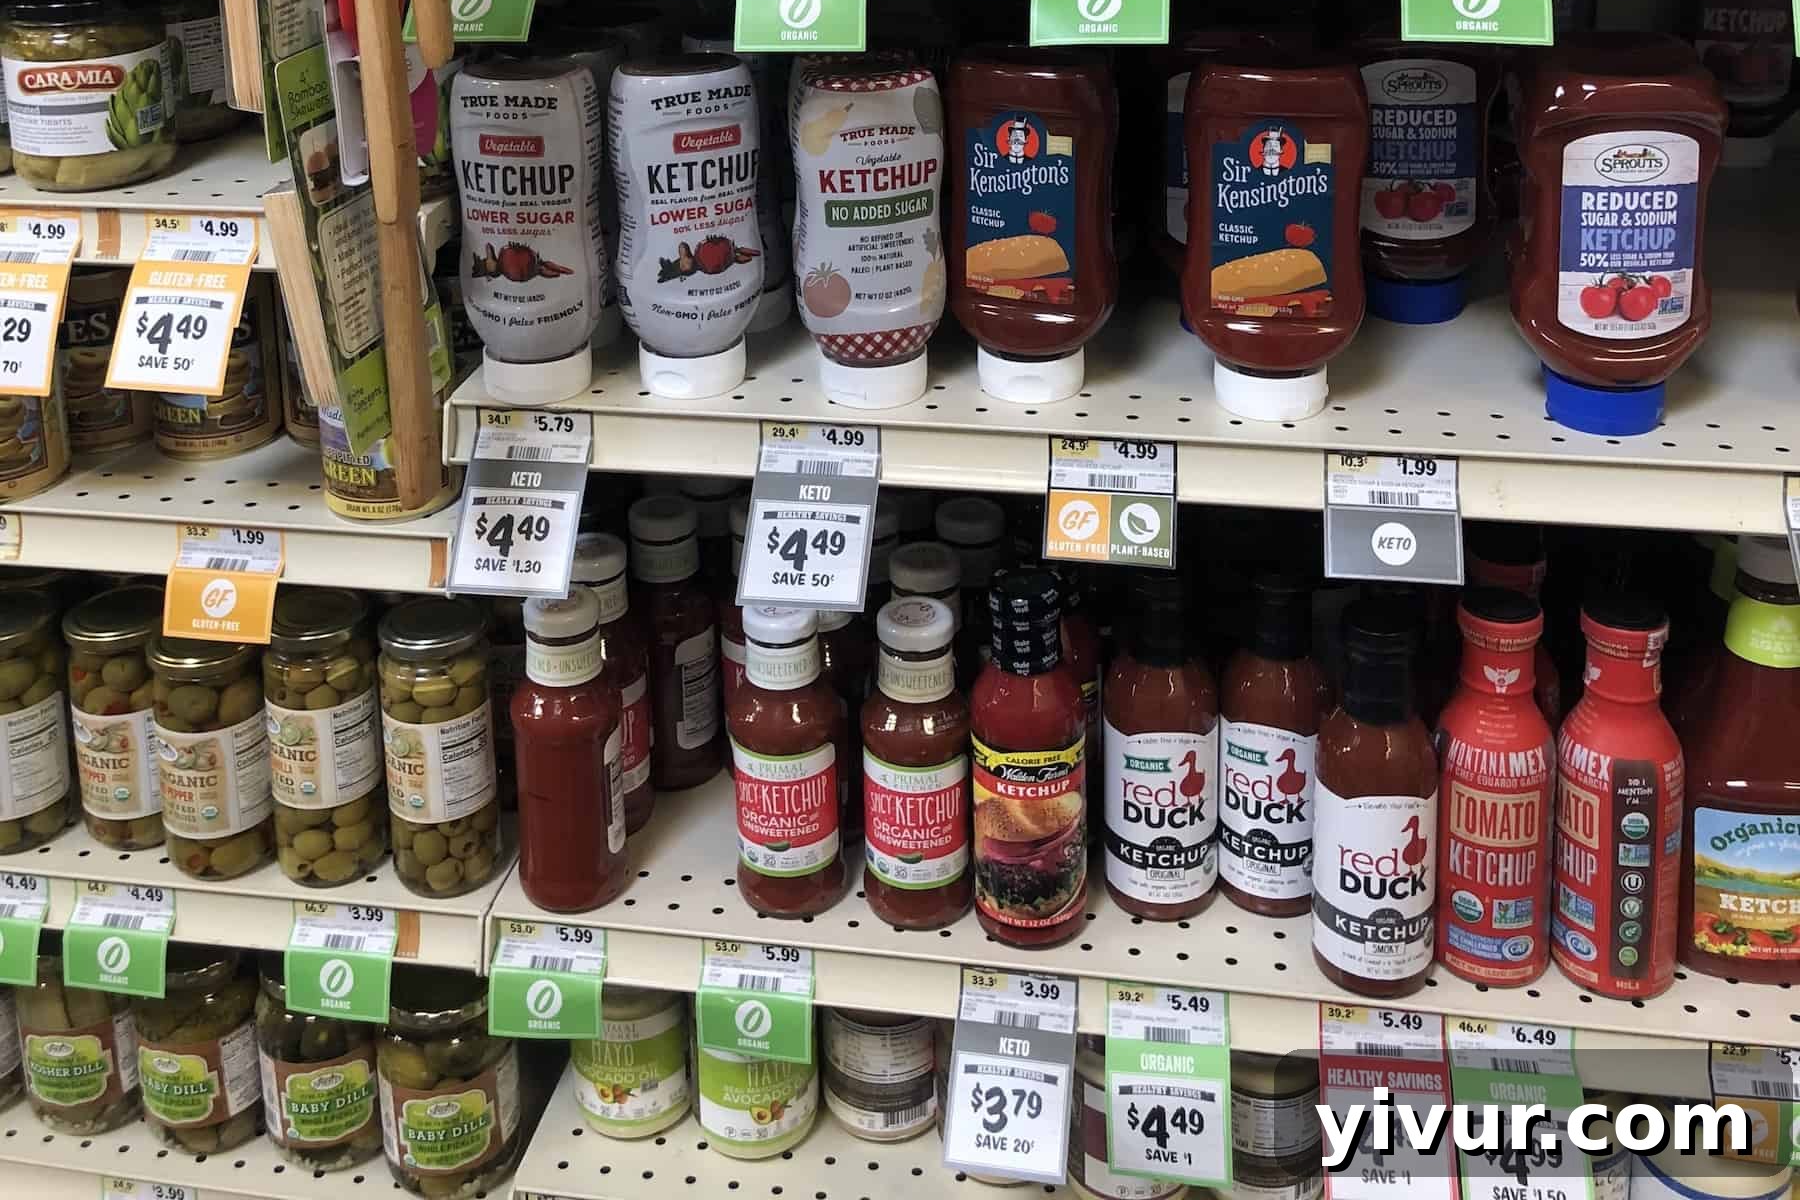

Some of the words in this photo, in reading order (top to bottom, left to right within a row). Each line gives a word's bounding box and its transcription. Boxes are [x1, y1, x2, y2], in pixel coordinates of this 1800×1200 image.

[781, 31, 818, 41] ORGANIC
[23, 73, 74, 90] CARA
[77, 70, 114, 87] MIA
[461, 95, 500, 109] TRUE
[504, 95, 558, 110] MADE
[651, 94, 702, 110] TRUE
[706, 85, 752, 100] MADE
[485, 111, 528, 120] FOODS
[1372, 109, 1457, 126] REDUCED
[974, 143, 999, 170] Sir
[462, 162, 575, 195] KETCHUP
[818, 159, 938, 193] KETCHUP
[1223, 157, 1251, 183] Sir
[831, 208, 849, 221] NO
[852, 202, 892, 220] ADDED
[894, 197, 927, 215] SUGAR
[1581, 191, 1678, 211] REDUCED
[466, 208, 511, 223] LOWER
[516, 210, 574, 225] SUGAR
[971, 206, 1001, 218] CLASSIC
[1581, 212, 1618, 226] SUGAR
[1621, 213, 1633, 225] &
[1635, 212, 1677, 225] SODIUM
[199, 219, 239, 238] $4.99
[971, 215, 1005, 228] KETCHUP
[1218, 223, 1254, 235] CLASSIC
[1218, 233, 1258, 244] KETCHUP
[1580, 229, 1676, 250] KETCHUP
[1580, 253, 1608, 267] 50%
[148, 272, 227, 288] GLUTEN-FREE
[138, 355, 168, 369] SAVE
[534, 416, 574, 432] $5.79
[821, 428, 864, 446] $4.99
[1113, 441, 1158, 460] $4.99
[510, 472, 541, 488] KETO
[799, 485, 831, 500] KETO
[232, 529, 264, 545] $1.99
[1377, 536, 1412, 551] KETO
[1111, 544, 1169, 559] PLANT-BASED
[474, 558, 506, 572] SAVE
[512, 559, 541, 574] $1.30
[772, 571, 807, 586] SAVE
[192, 620, 240, 631] GLUTEN-FREE
[996, 780, 1070, 797] KETCHUP
[1121, 778, 1177, 807] red
[1122, 801, 1207, 828] DUCK
[1225, 788, 1306, 824] DUCK
[1454, 790, 1536, 840] TOMATO
[742, 812, 807, 828] ORGANIC
[743, 822, 819, 838] UNSWEETENED
[872, 820, 942, 839] ORGANIC
[1119, 842, 1209, 867] KETCHUP
[1338, 845, 1398, 876] red
[1339, 867, 1427, 900] DUCK
[348, 904, 383, 922] $3.99
[556, 926, 592, 944] $5.99
[1335, 915, 1430, 940] KETCHUP
[762, 944, 799, 962] $5.99
[738, 1038, 769, 1049] ORGANIC
[1511, 1026, 1556, 1045] $6.49
[999, 1037, 1030, 1055] KETO
[73, 1060, 103, 1075] DILL
[1140, 1054, 1194, 1073] ORGANIC
[173, 1082, 208, 1095] DILL
[1327, 1069, 1383, 1086] HEALTHY
[1388, 1071, 1441, 1090] SAVINGS
[291, 1101, 332, 1114] BABY
[336, 1087, 369, 1108] DILL
[408, 1128, 447, 1141] BABY
[451, 1117, 487, 1136] DILL
[975, 1134, 1007, 1151] SAVE
